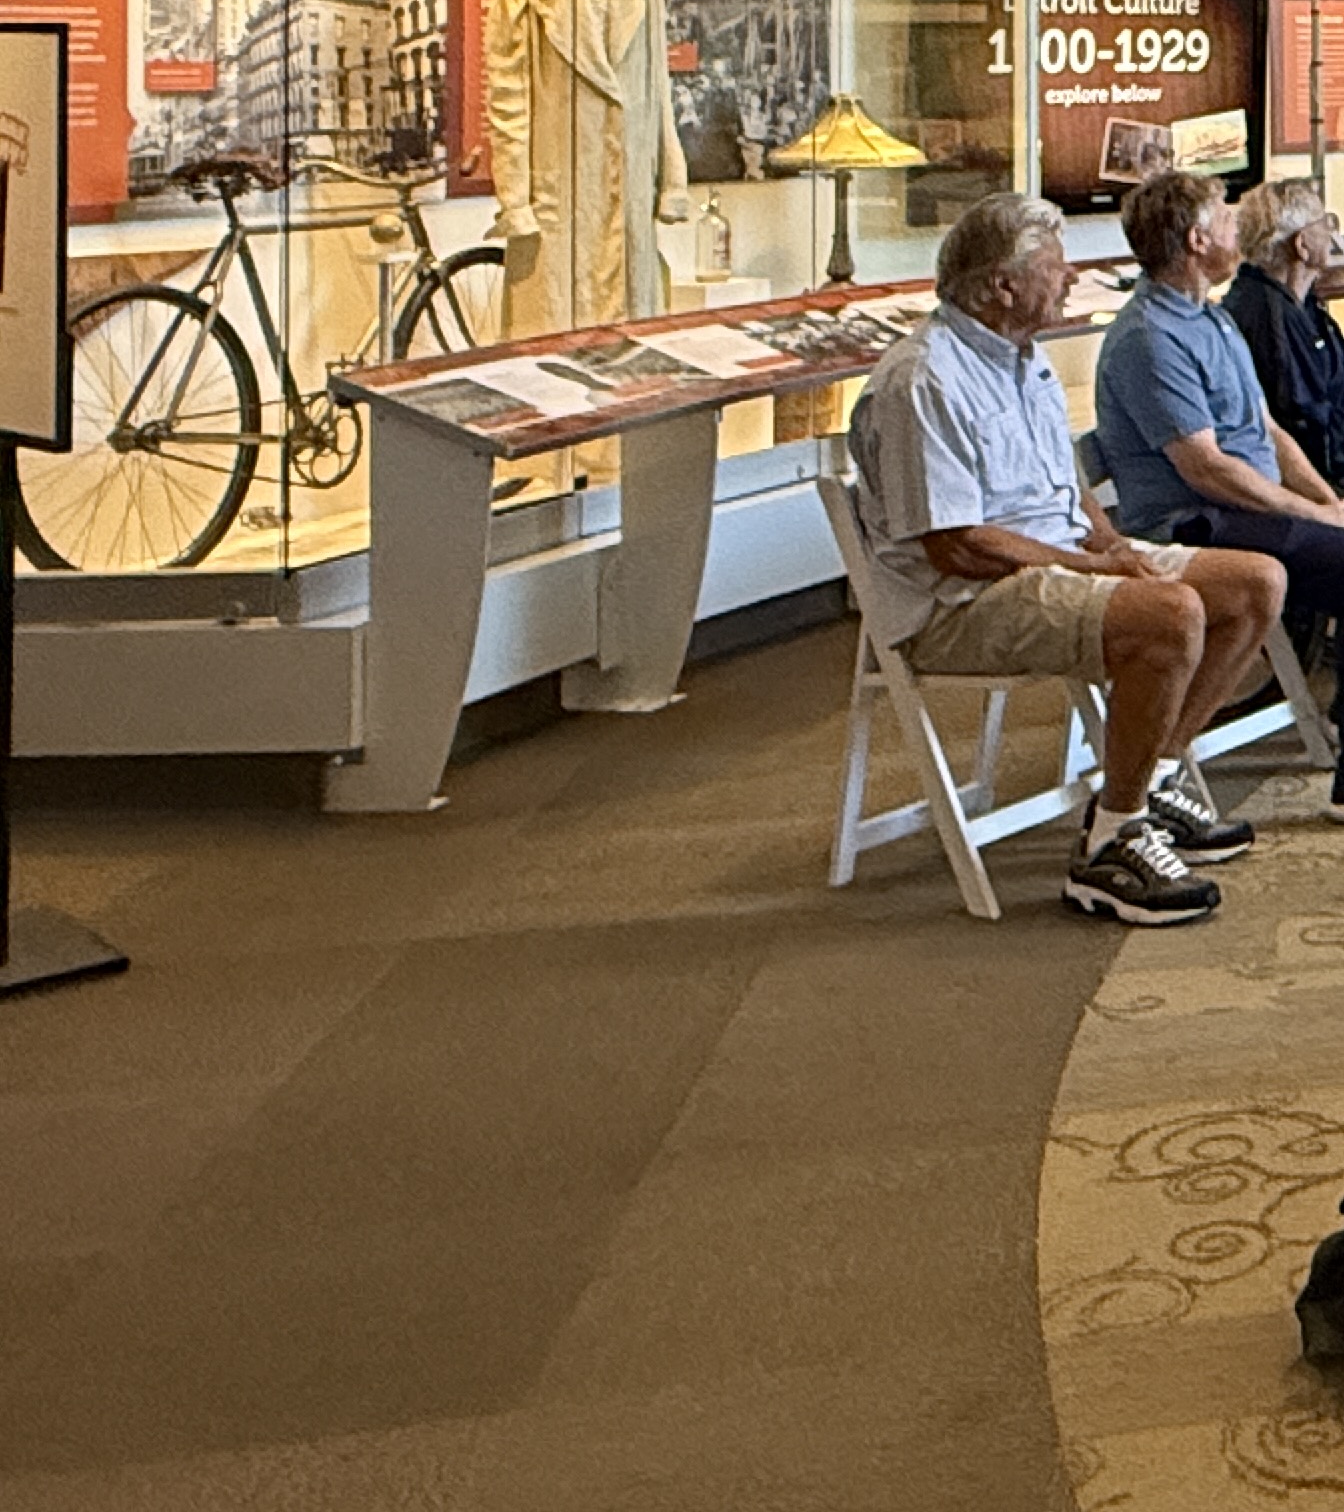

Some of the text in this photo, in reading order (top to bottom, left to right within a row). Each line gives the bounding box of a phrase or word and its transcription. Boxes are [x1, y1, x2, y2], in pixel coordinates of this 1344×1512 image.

[986, 28, 1211, 75] 100-1929
[1045, 84, 1162, 107] explore below
